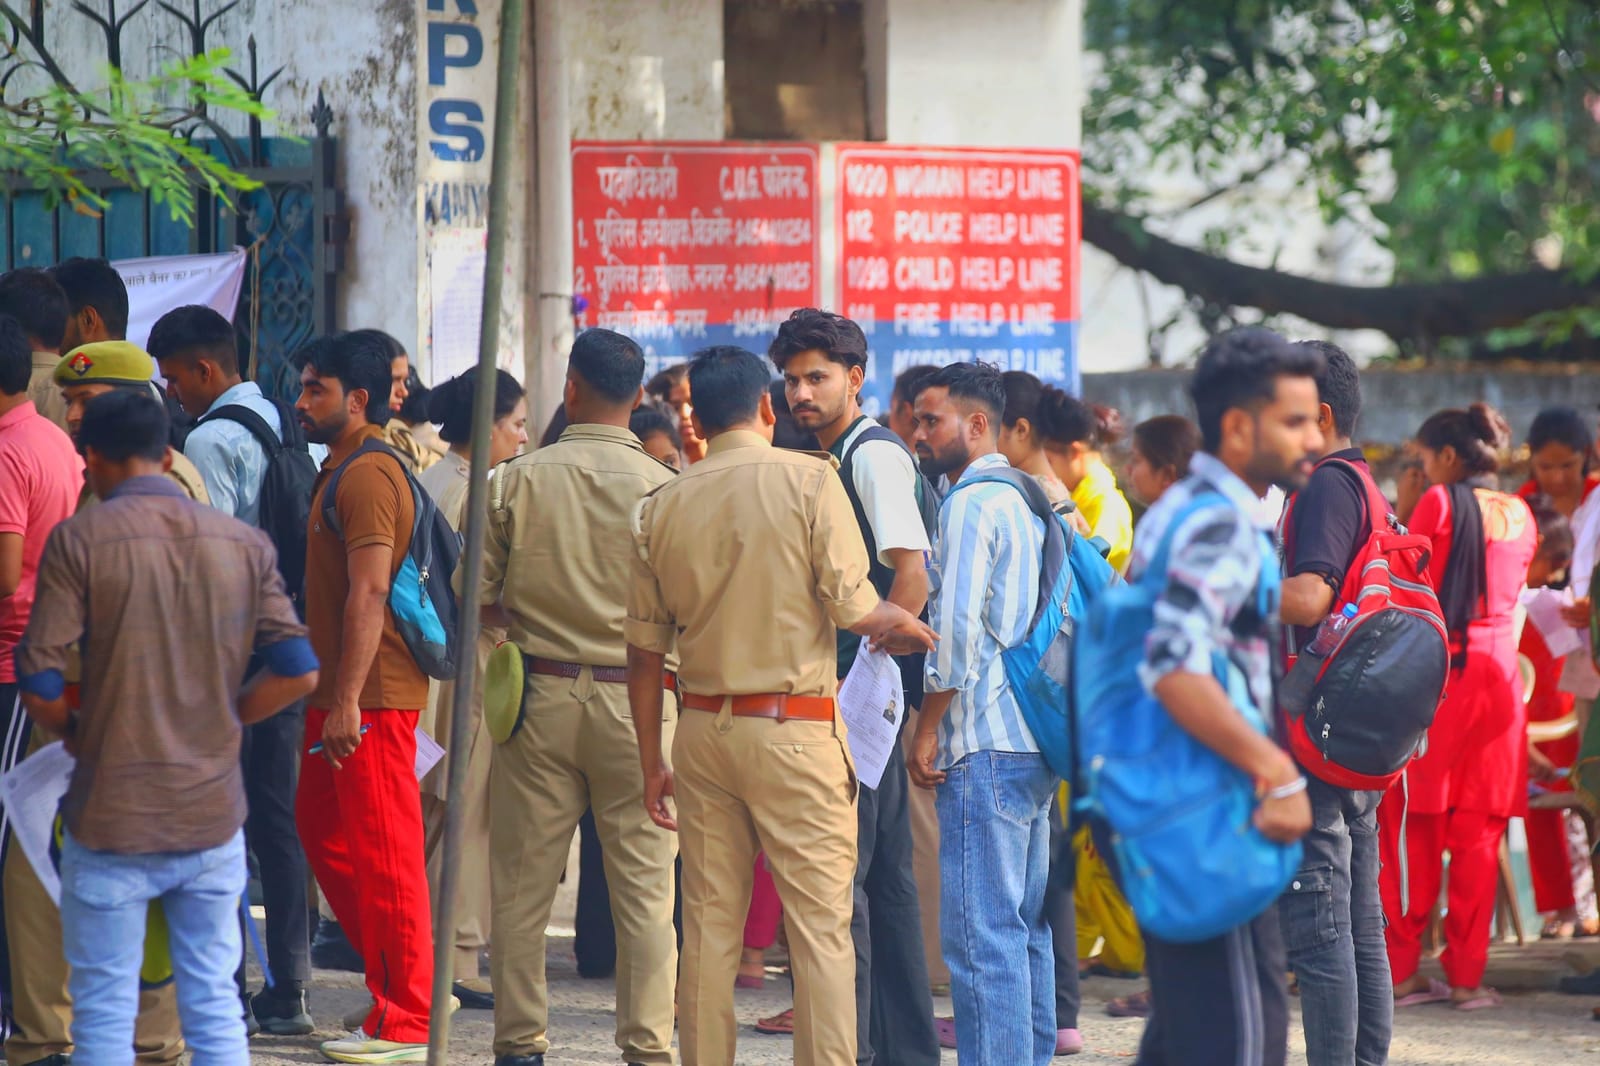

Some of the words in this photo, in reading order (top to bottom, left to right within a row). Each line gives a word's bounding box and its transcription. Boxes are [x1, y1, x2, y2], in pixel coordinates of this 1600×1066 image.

[846, 163, 888, 198] 1090
[967, 167, 1015, 199] HELP
[1017, 168, 1064, 200] LINE
[846, 209, 874, 242] 112
[894, 210, 965, 244] POLICE
[969, 212, 1018, 245] HELP
[1019, 213, 1065, 246] LINE
[894, 256, 954, 292] CHILD
[960, 257, 1014, 291] HELP
[1017, 257, 1063, 292] LINE
[894, 302, 941, 337] FIRE
[950, 302, 1006, 337] HELP
[1010, 302, 1055, 337] LINE
